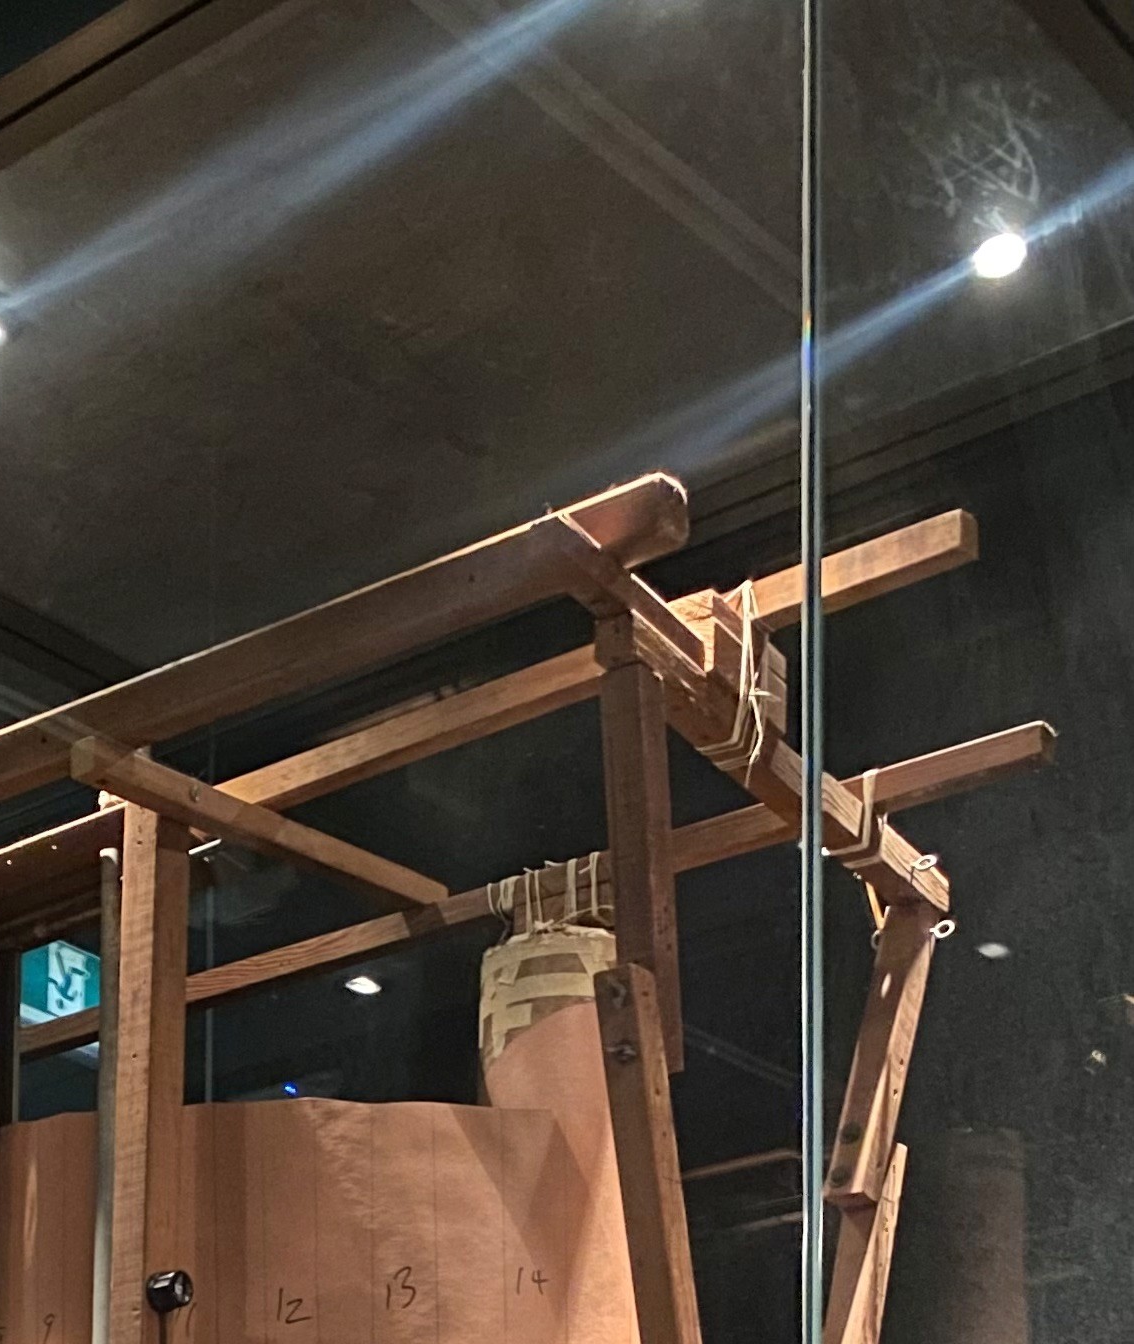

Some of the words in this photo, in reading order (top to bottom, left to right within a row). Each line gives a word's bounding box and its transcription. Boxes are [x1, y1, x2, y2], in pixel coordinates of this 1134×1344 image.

[386, 1266, 416, 1310] 13
[516, 1267, 549, 1296] 14
[276, 1287, 312, 1324] 12
